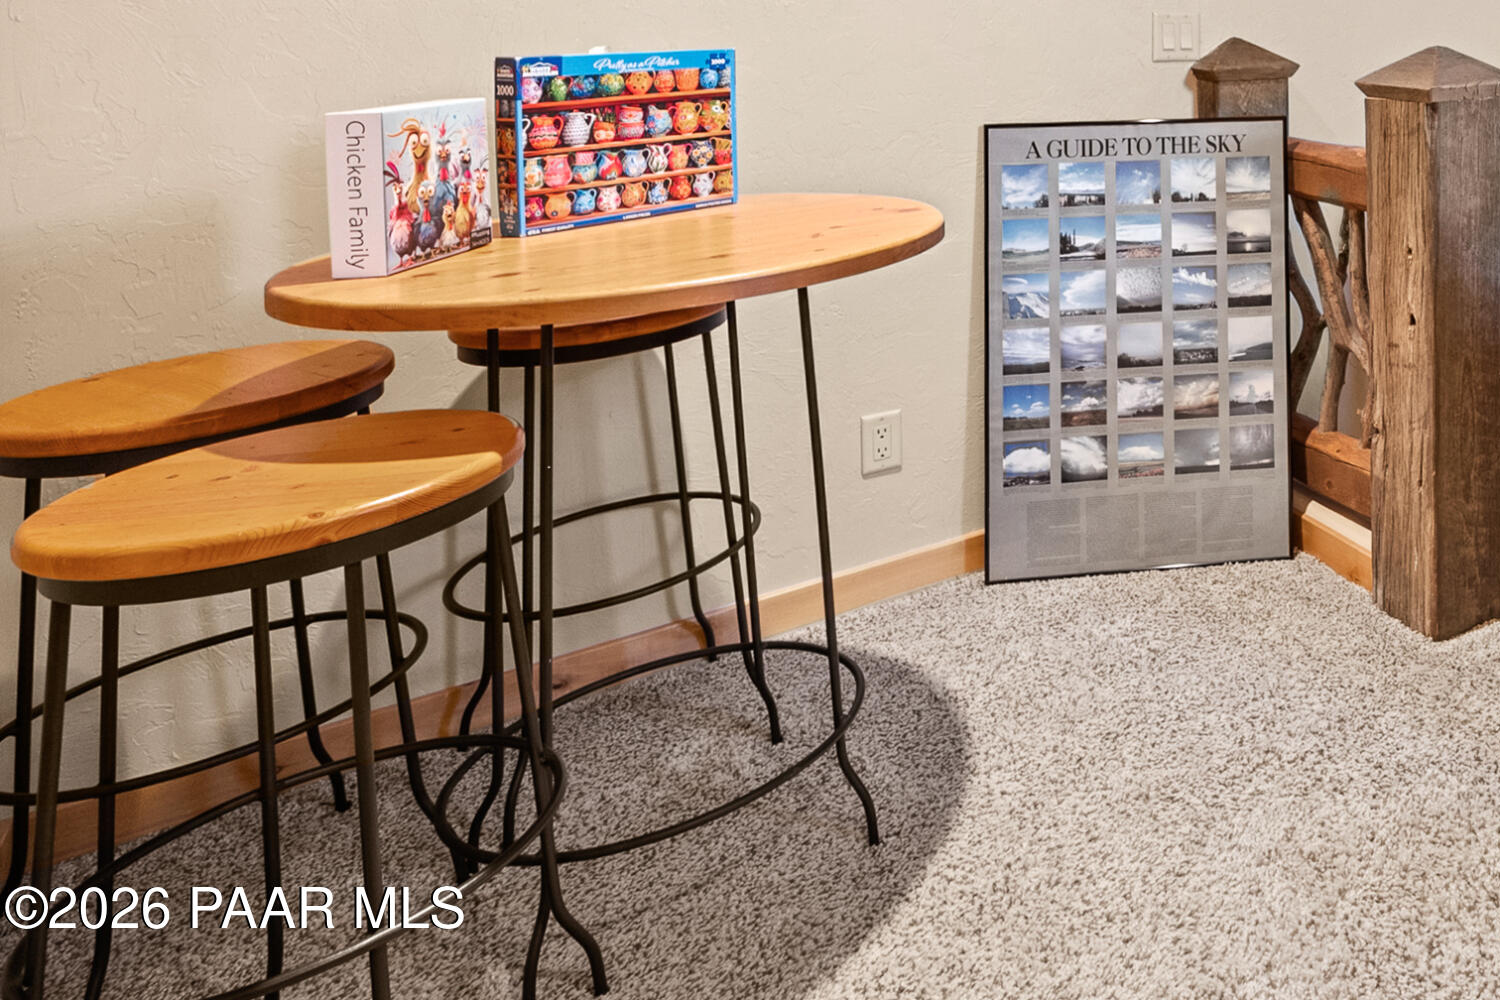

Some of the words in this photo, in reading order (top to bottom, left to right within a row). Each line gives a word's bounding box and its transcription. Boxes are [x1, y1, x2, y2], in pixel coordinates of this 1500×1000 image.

[496, 84, 514, 96] 1000
[345, 120, 366, 200] Chicken
[1025, 140, 1042, 159] A
[1046, 137, 1118, 159] GUIDE
[1121, 136, 1153, 157] TO
[1155, 135, 1201, 155] THE
[1205, 133, 1247, 154] SKY
[345, 206, 370, 270] Family
